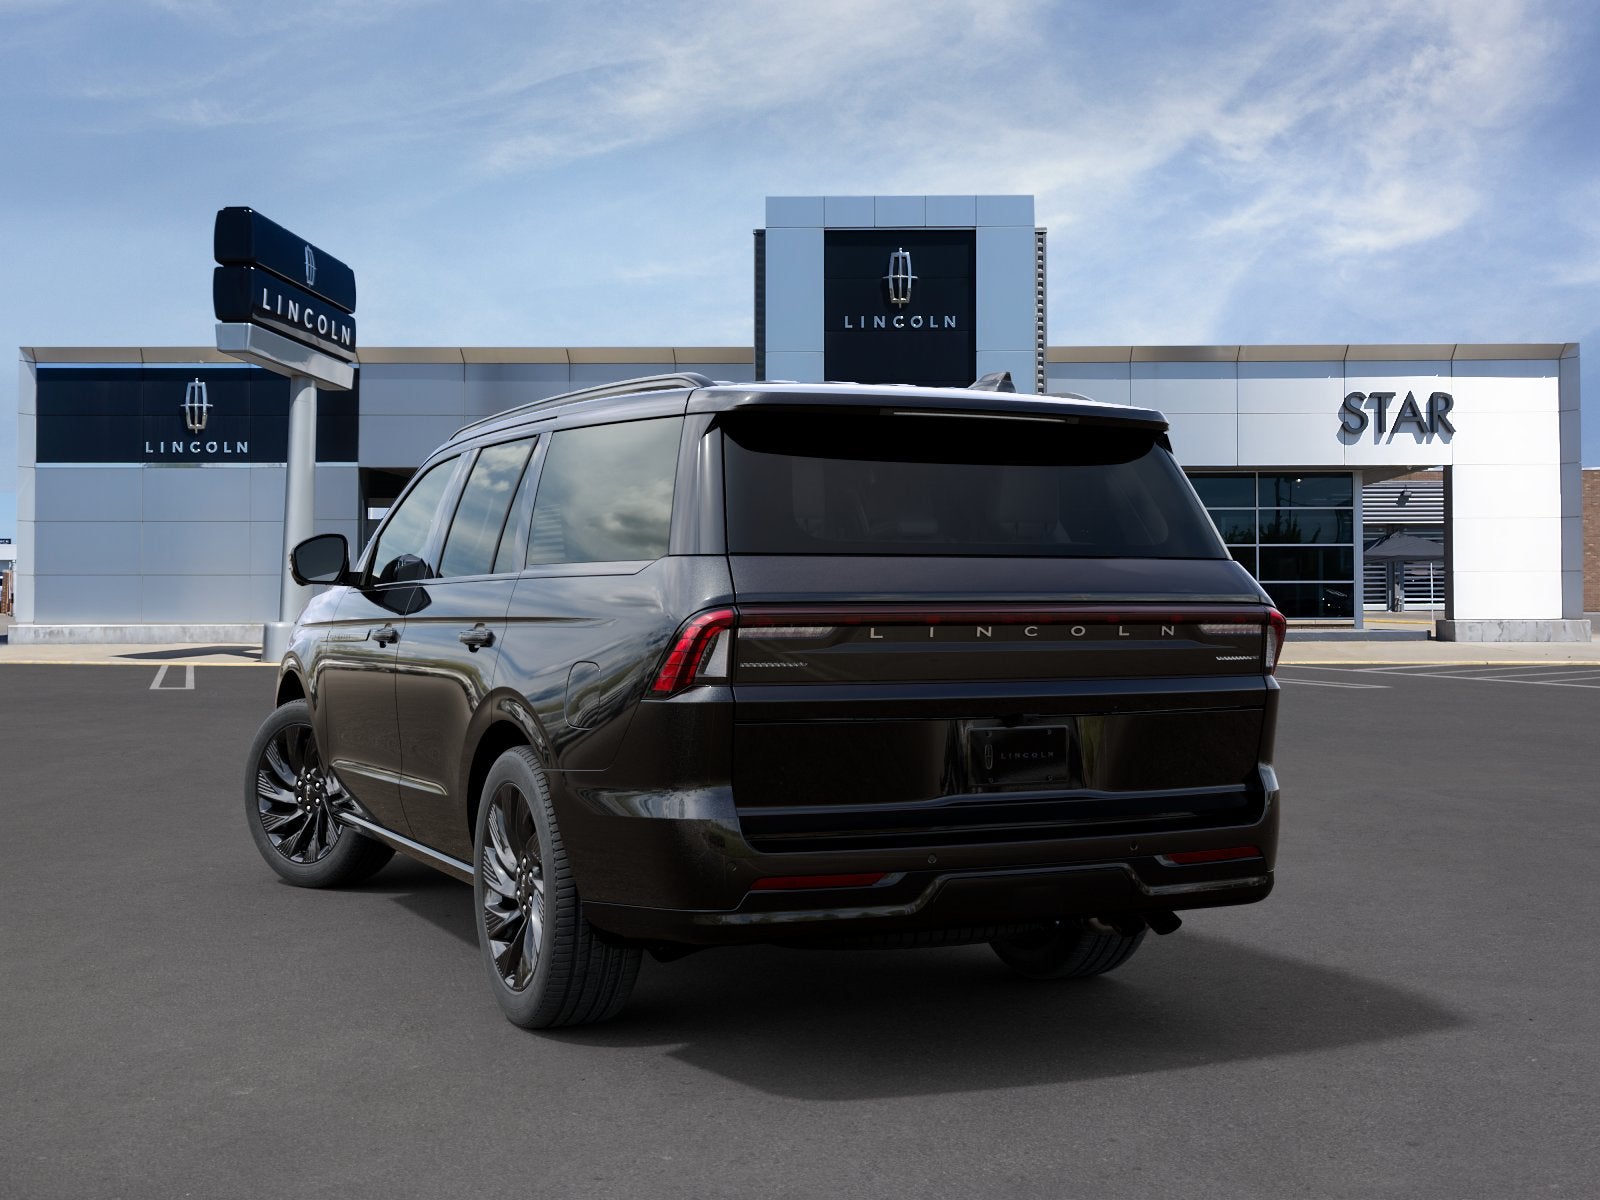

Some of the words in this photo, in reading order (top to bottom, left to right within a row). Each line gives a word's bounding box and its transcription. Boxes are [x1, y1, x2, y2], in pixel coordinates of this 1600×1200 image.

[262, 287, 351, 346] LINCOLN
[844, 315, 957, 329] LINCOLN
[1342, 390, 1456, 434] STAR
[145, 441, 249, 454] LINCOLN
[869, 625, 1176, 639] LINCOLN
[1000, 751, 1055, 760] LINCOLN
